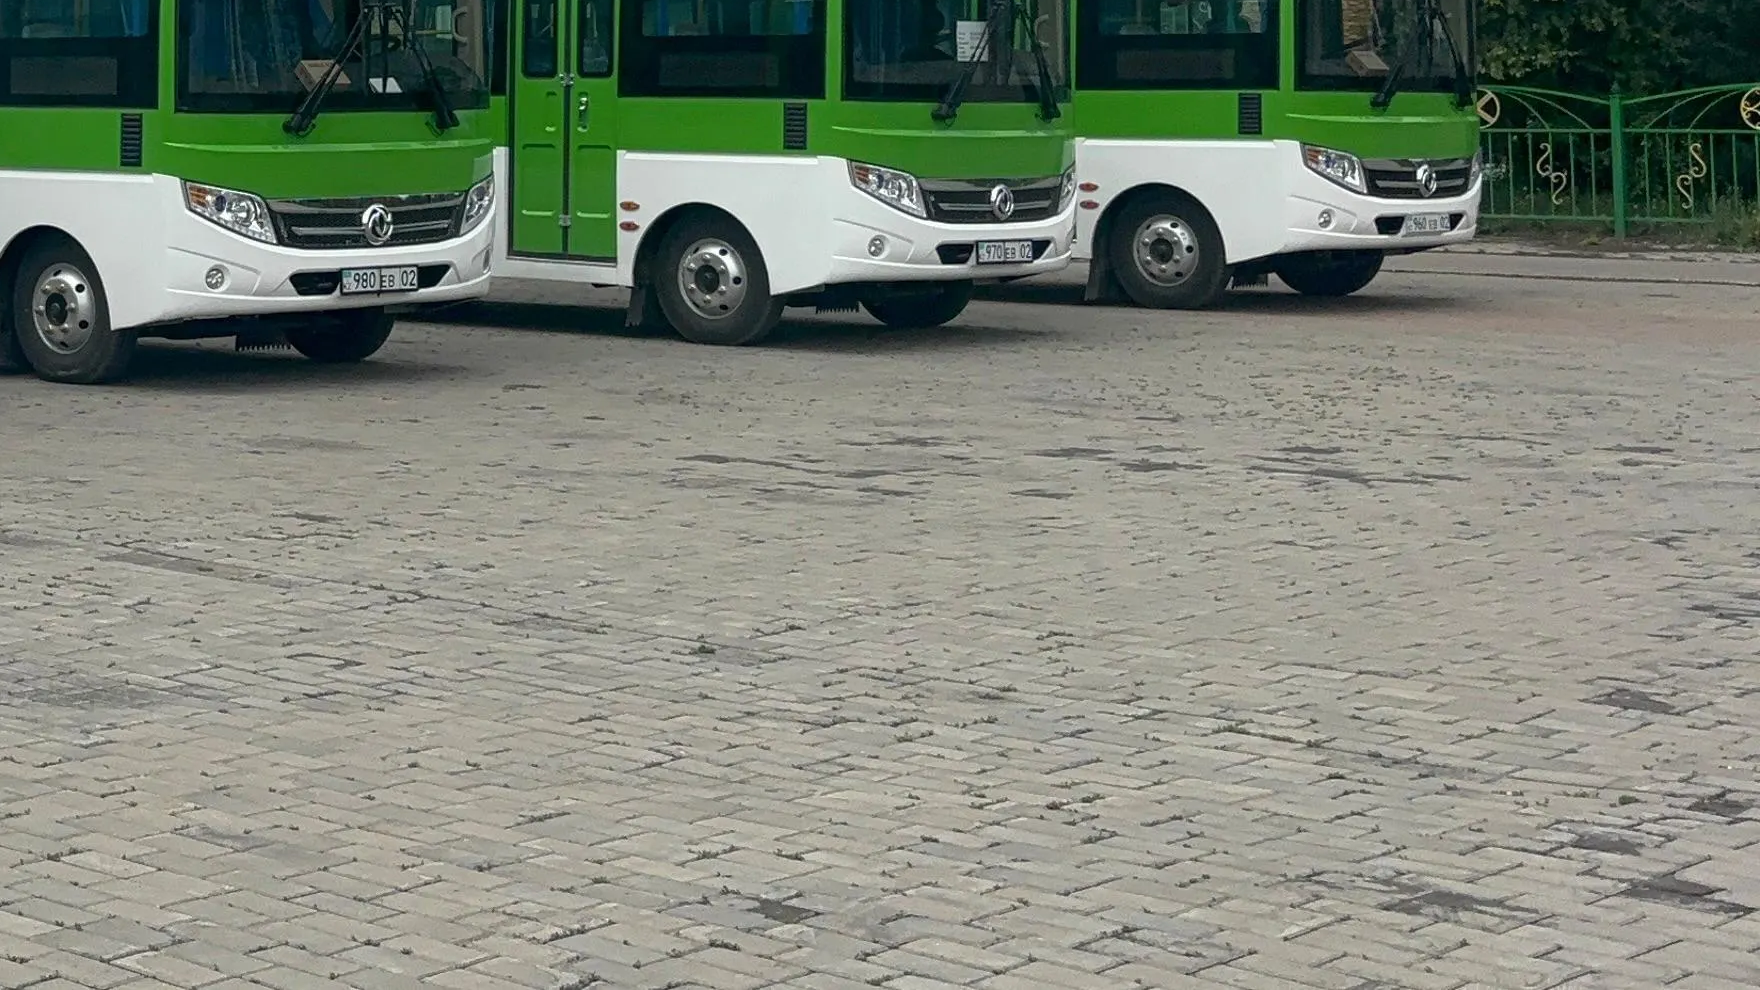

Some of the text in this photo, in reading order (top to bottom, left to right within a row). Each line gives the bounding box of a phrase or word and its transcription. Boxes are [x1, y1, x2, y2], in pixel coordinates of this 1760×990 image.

[986, 245, 1002, 259] 970
[1020, 243, 1032, 258] 02
[353, 270, 416, 289] 980 EB 02
